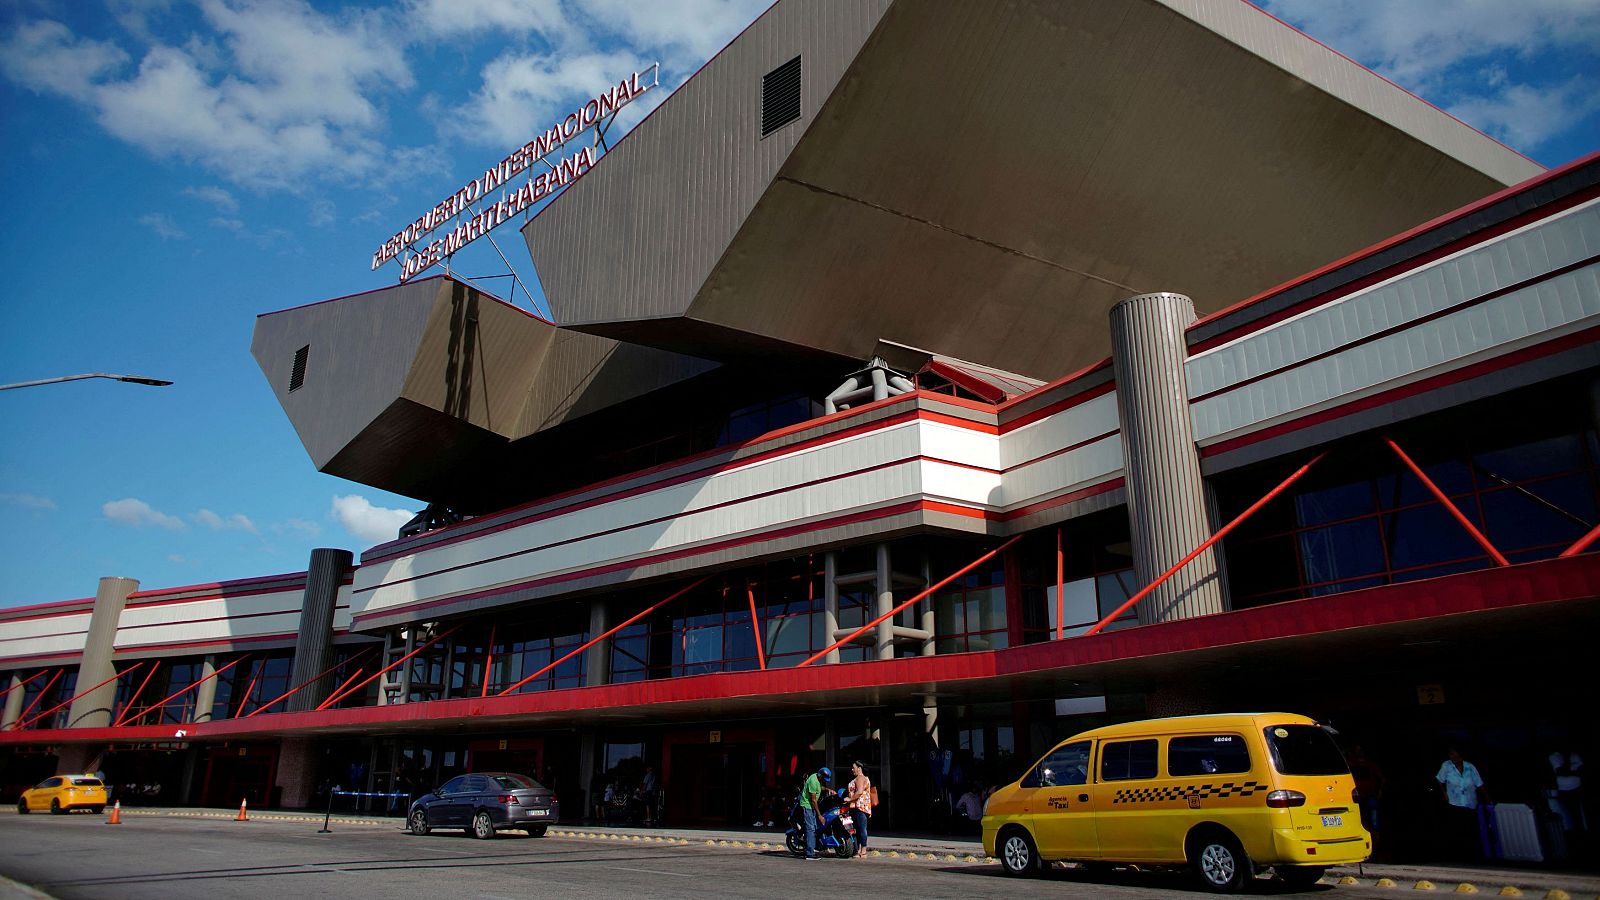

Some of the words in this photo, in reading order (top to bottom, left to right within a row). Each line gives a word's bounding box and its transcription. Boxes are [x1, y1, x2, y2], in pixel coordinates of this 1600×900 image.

[375, 180, 480, 267] AEROPUERTO
[483, 72, 646, 193] INTERNACIONAL
[1054, 800, 1069, 809] Taxi
